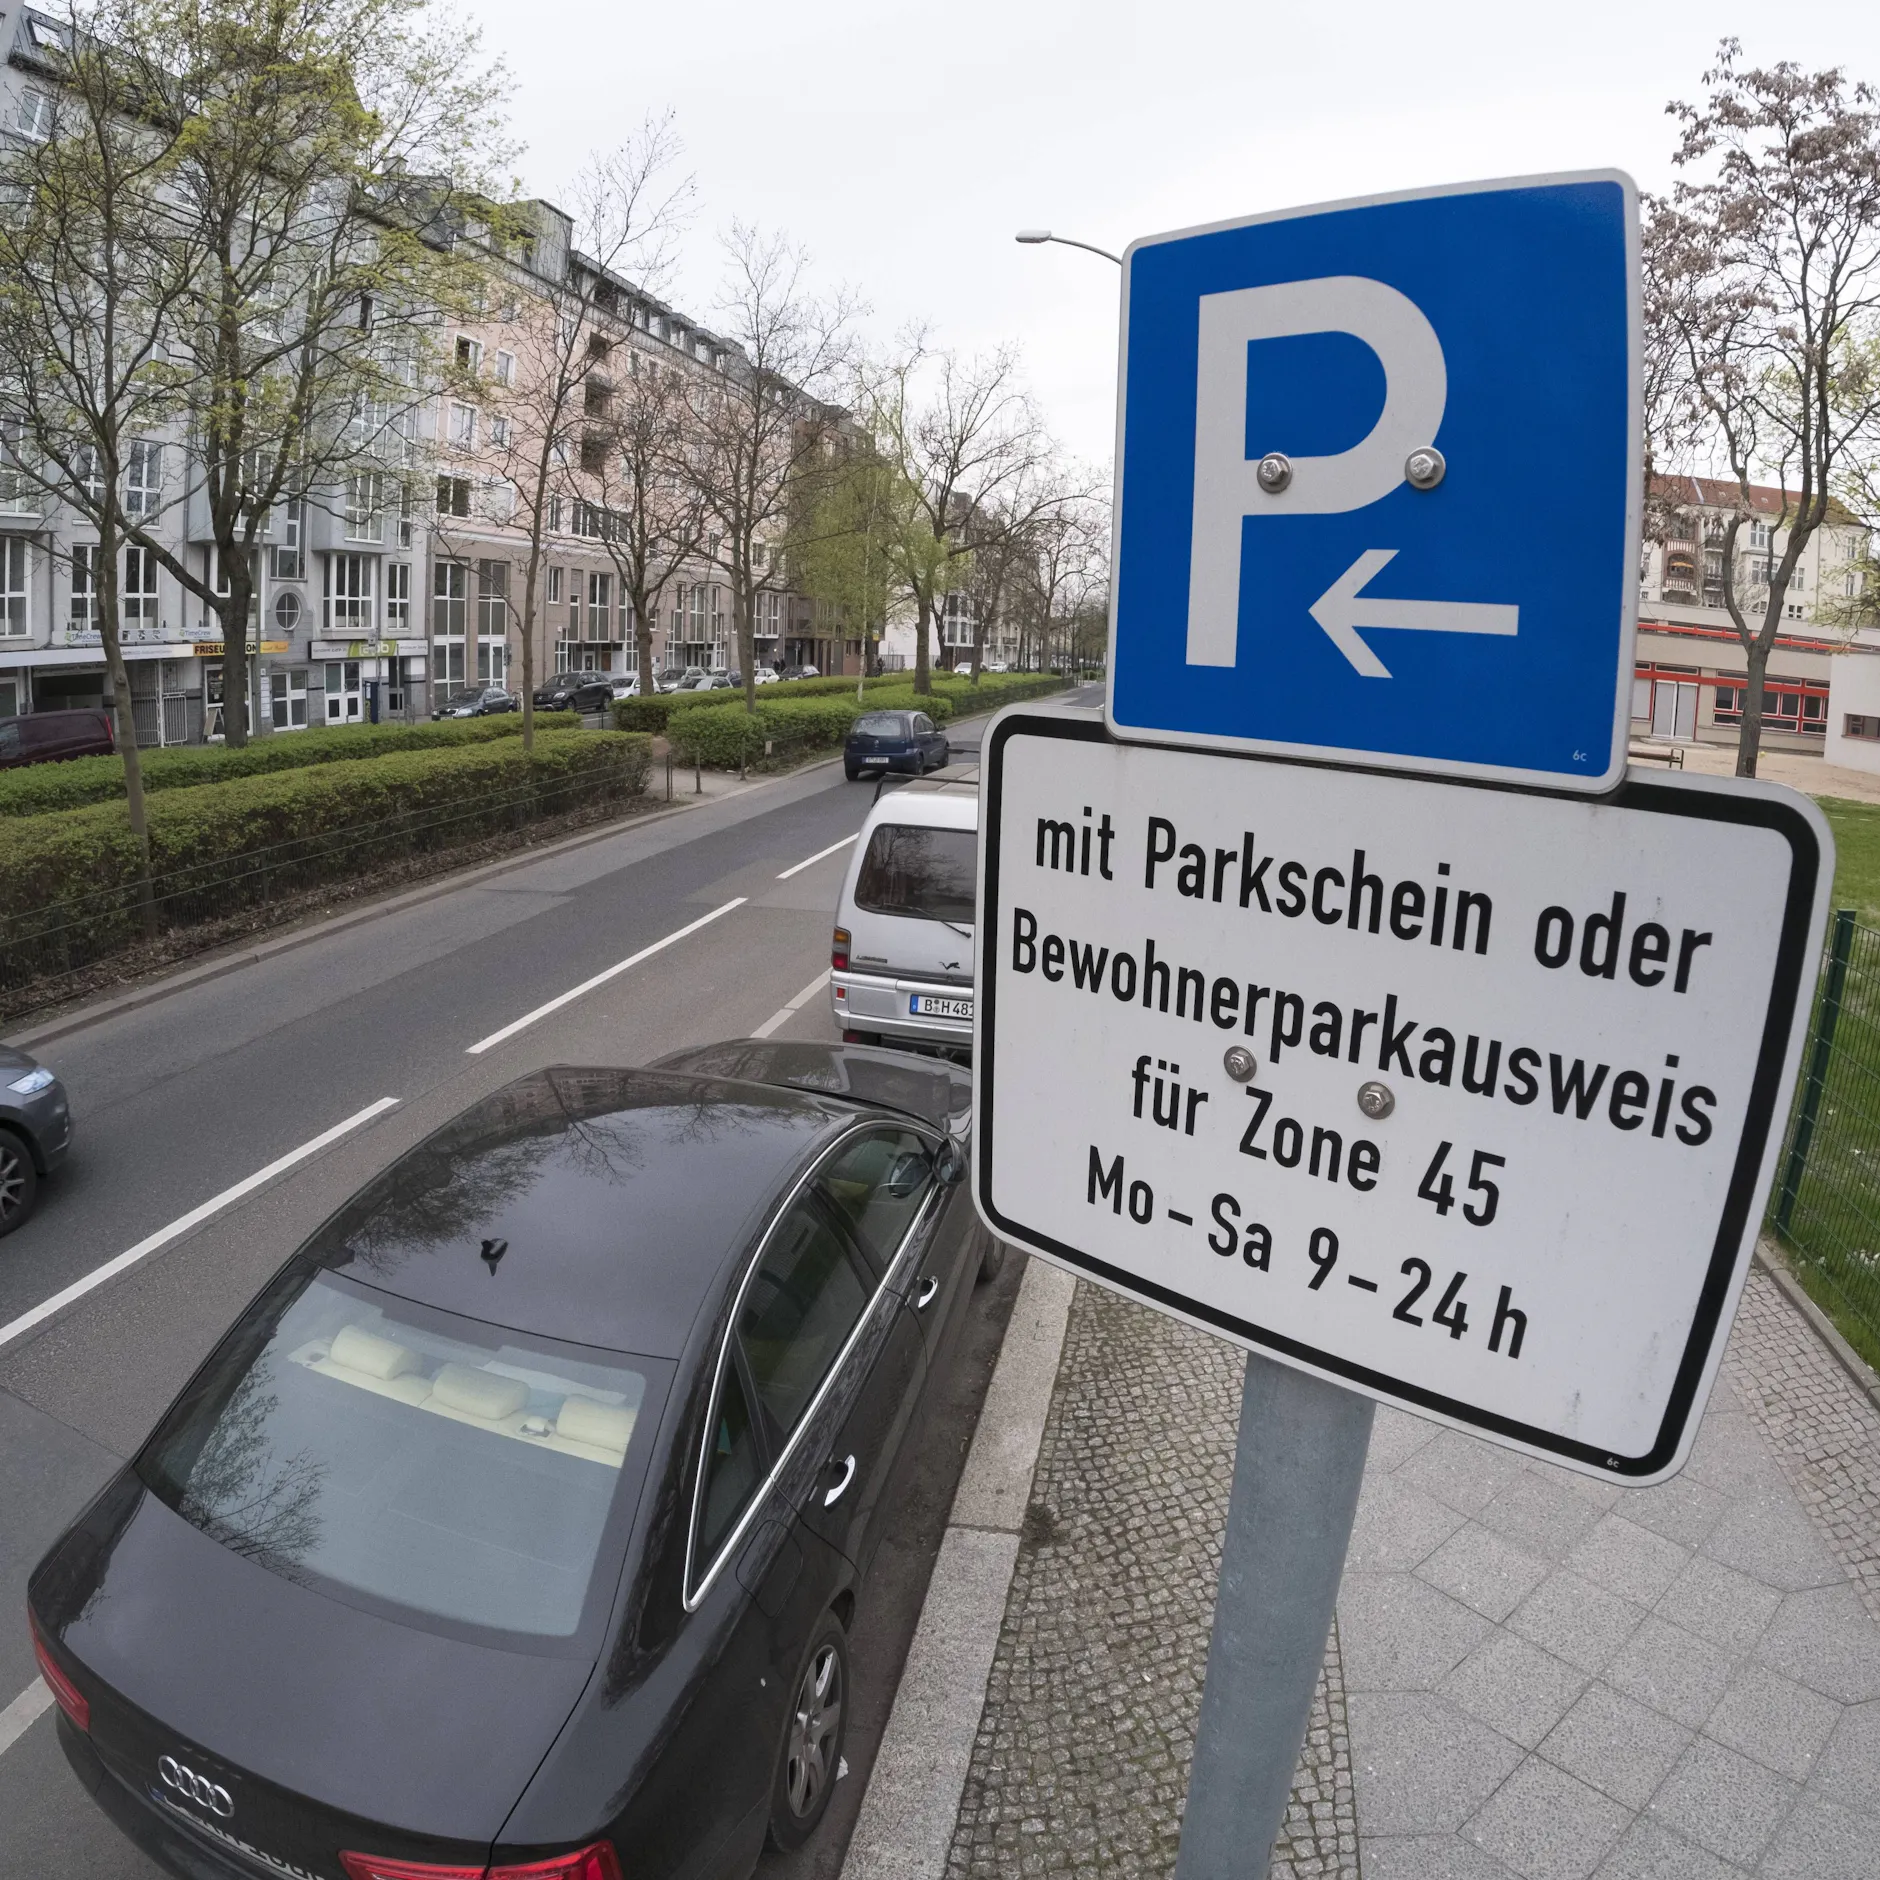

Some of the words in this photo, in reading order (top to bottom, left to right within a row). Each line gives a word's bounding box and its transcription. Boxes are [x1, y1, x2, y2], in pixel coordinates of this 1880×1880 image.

[1186, 276, 1447, 667] P
[1037, 807, 1114, 881] mit
[1145, 817, 1492, 955] Parkschein
[1535, 891, 1712, 993] oder
[1013, 908, 1716, 1146] Bewohnerparkausweis
[1132, 1056, 1208, 1136] für
[1240, 1086, 1380, 1191] Zone
[1418, 1141, 1505, 1226] 45
